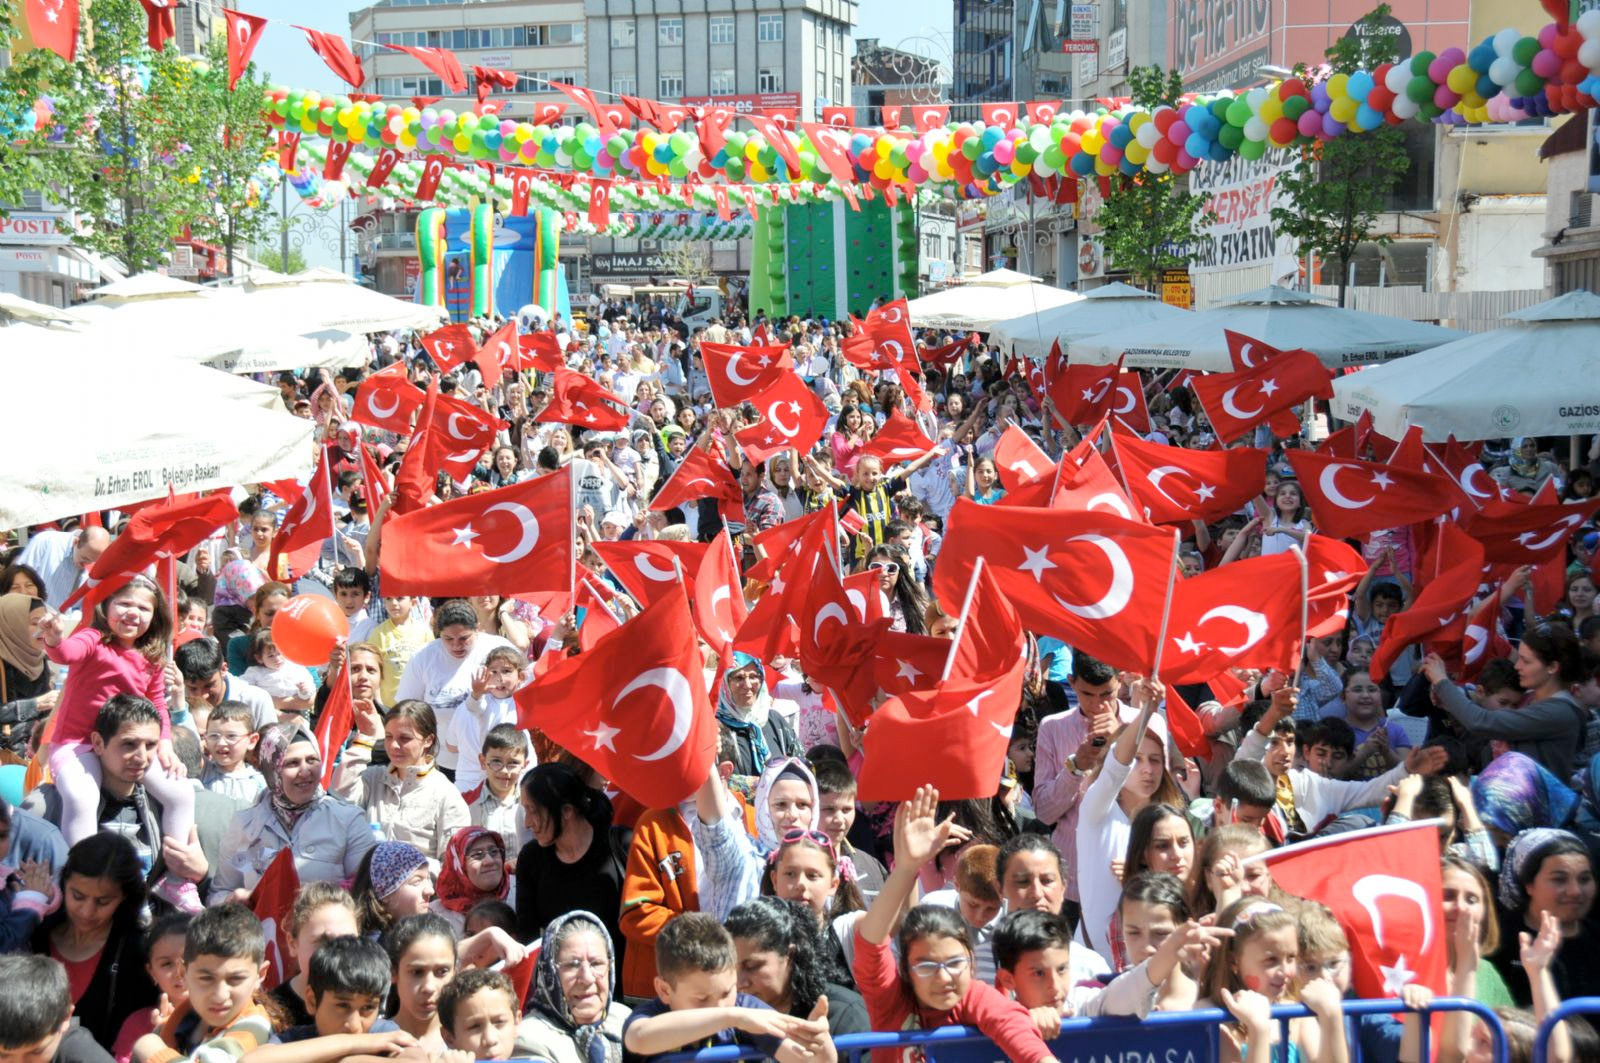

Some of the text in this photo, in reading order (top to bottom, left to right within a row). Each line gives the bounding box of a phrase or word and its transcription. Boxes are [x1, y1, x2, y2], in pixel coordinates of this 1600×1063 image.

[1238, 61, 1252, 80] her
[94, 463, 220, 496] Dr. Erhan EROL Belediye Başkanı
